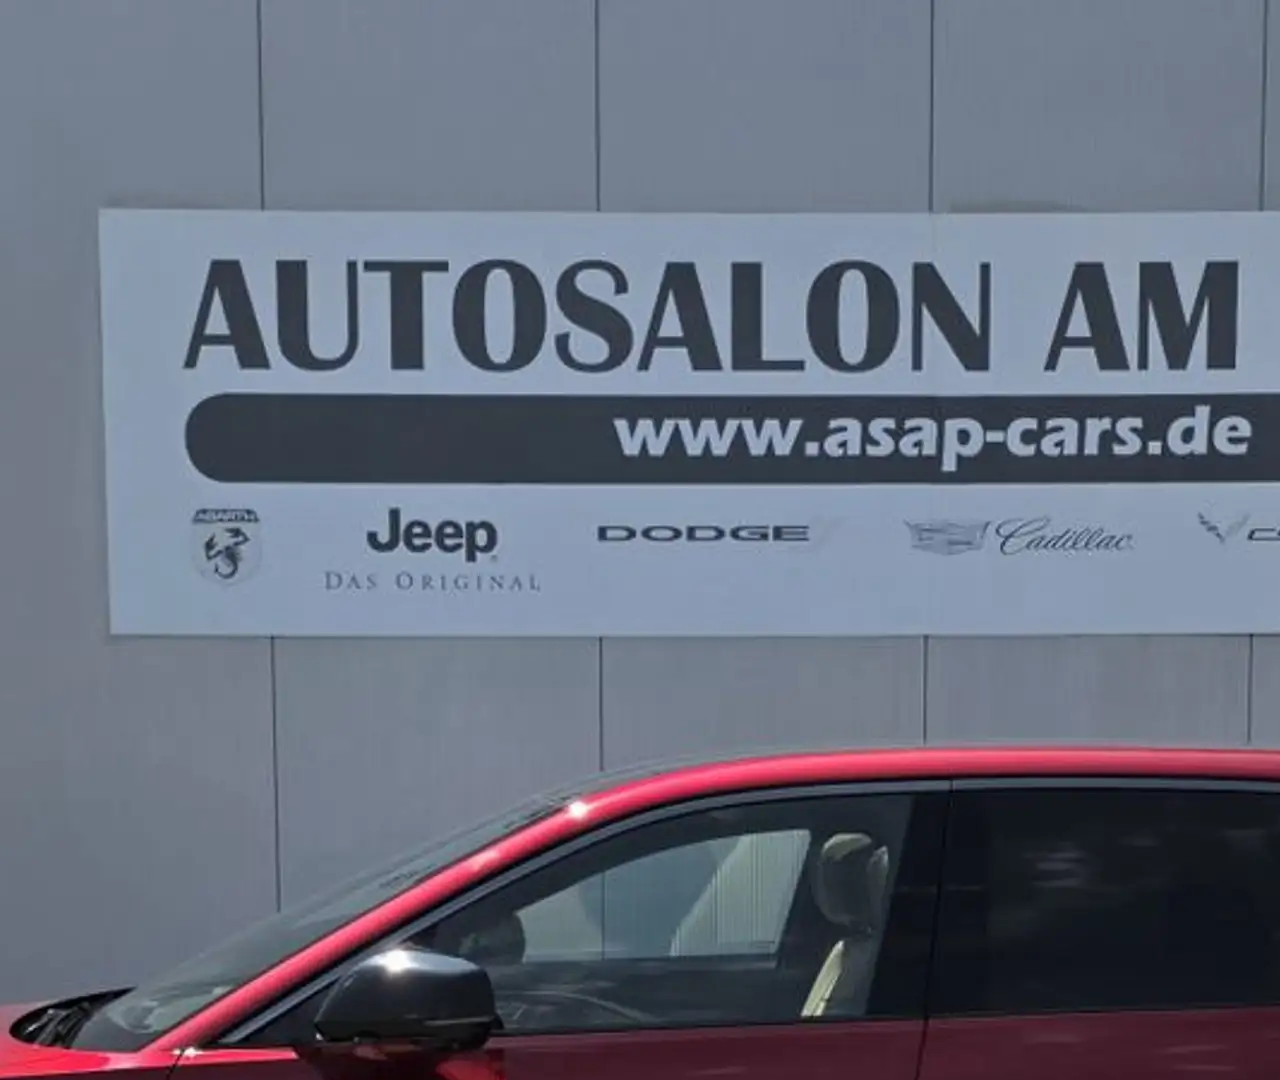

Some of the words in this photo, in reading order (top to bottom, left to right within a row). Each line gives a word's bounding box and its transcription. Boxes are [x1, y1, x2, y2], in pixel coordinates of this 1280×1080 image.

[182, 258, 992, 373] AUTOSALON
[1043, 260, 1240, 372] AM
[613, 405, 1253, 472] www.asap-cars.de
[366, 507, 498, 563] Jeep
[596, 523, 810, 543] DODGE
[994, 515, 1134, 556] Cadillac
[324, 571, 378, 591] DAS
[395, 570, 541, 594] ORIGINAL
